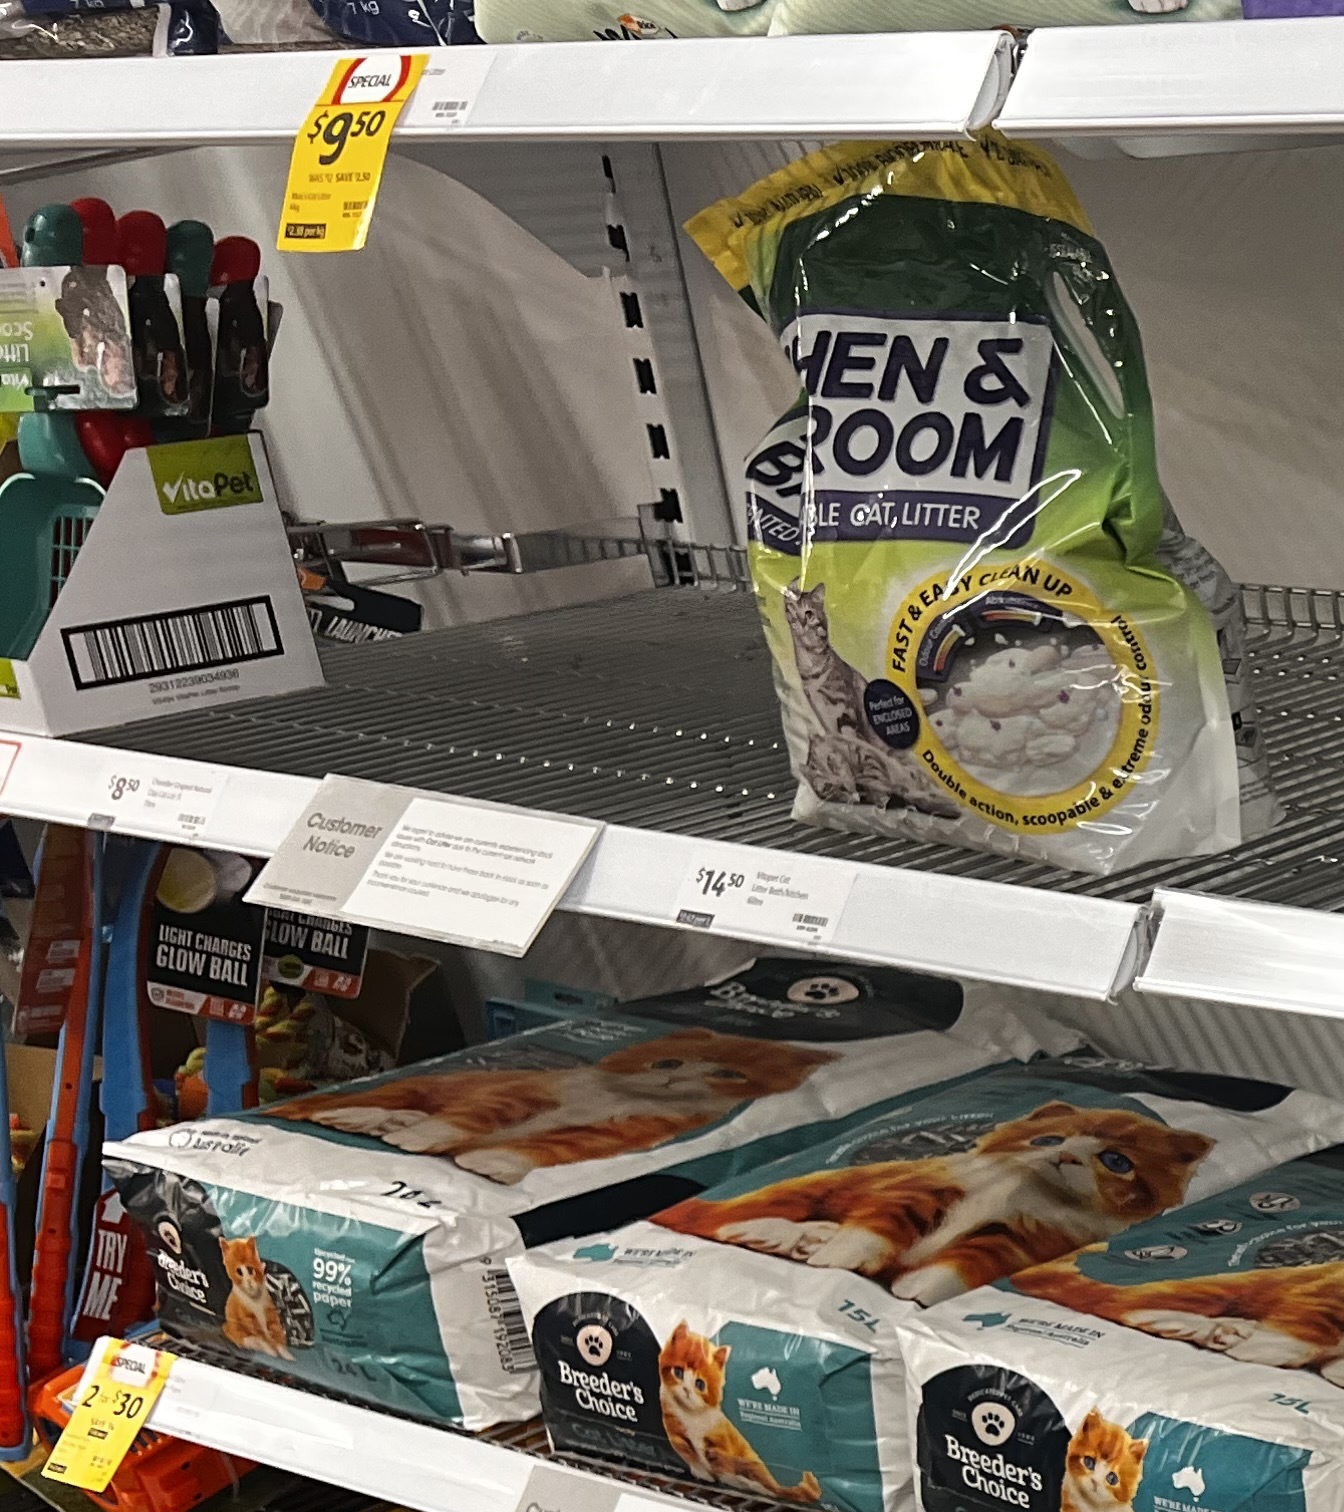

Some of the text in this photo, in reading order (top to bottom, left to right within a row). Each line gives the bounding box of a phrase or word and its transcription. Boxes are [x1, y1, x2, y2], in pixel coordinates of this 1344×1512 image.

[348, 74, 391, 88] SPECIAL
[962, 338, 1030, 407] &
[162, 471, 253, 502] VitaPet
[901, 503, 980, 530] LITTER
[892, 619, 914, 672] FAST
[909, 605, 922, 620] &
[979, 564, 1040, 588] CLEAN
[1044, 574, 1072, 597] UP
[1111, 615, 1146, 671] control
[872, 708, 912, 724] ENCLOSED
[1112, 729, 1149, 789] extreme
[921, 750, 966, 800] Double
[1099, 786, 1114, 800] &
[307, 812, 383, 840] Customer
[970, 798, 1019, 825] action,
[1022, 795, 1100, 826] scoopable
[303, 835, 355, 859] Notice
[159, 925, 251, 960] LIGHT CHARGES
[311, 930, 349, 959] BALL
[156, 945, 248, 987] GLOW BALL
[96, 1229, 127, 1274] TRY
[312, 1258, 352, 1285] 99%
[83, 1271, 122, 1320] ME
[312, 1281, 352, 1296] recycled
[313, 1292, 352, 1308] paper
[837, 1298, 879, 1334] 15L
[114, 1357, 146, 1375] SPECIAL
[557, 1359, 644, 1404] Breeder's
[575, 1388, 638, 1422] Choice
[945, 1434, 1042, 1491] Breeder's
[962, 1466, 1030, 1508] Choice
[1154, 1495, 1181, 1511] WE'RE
